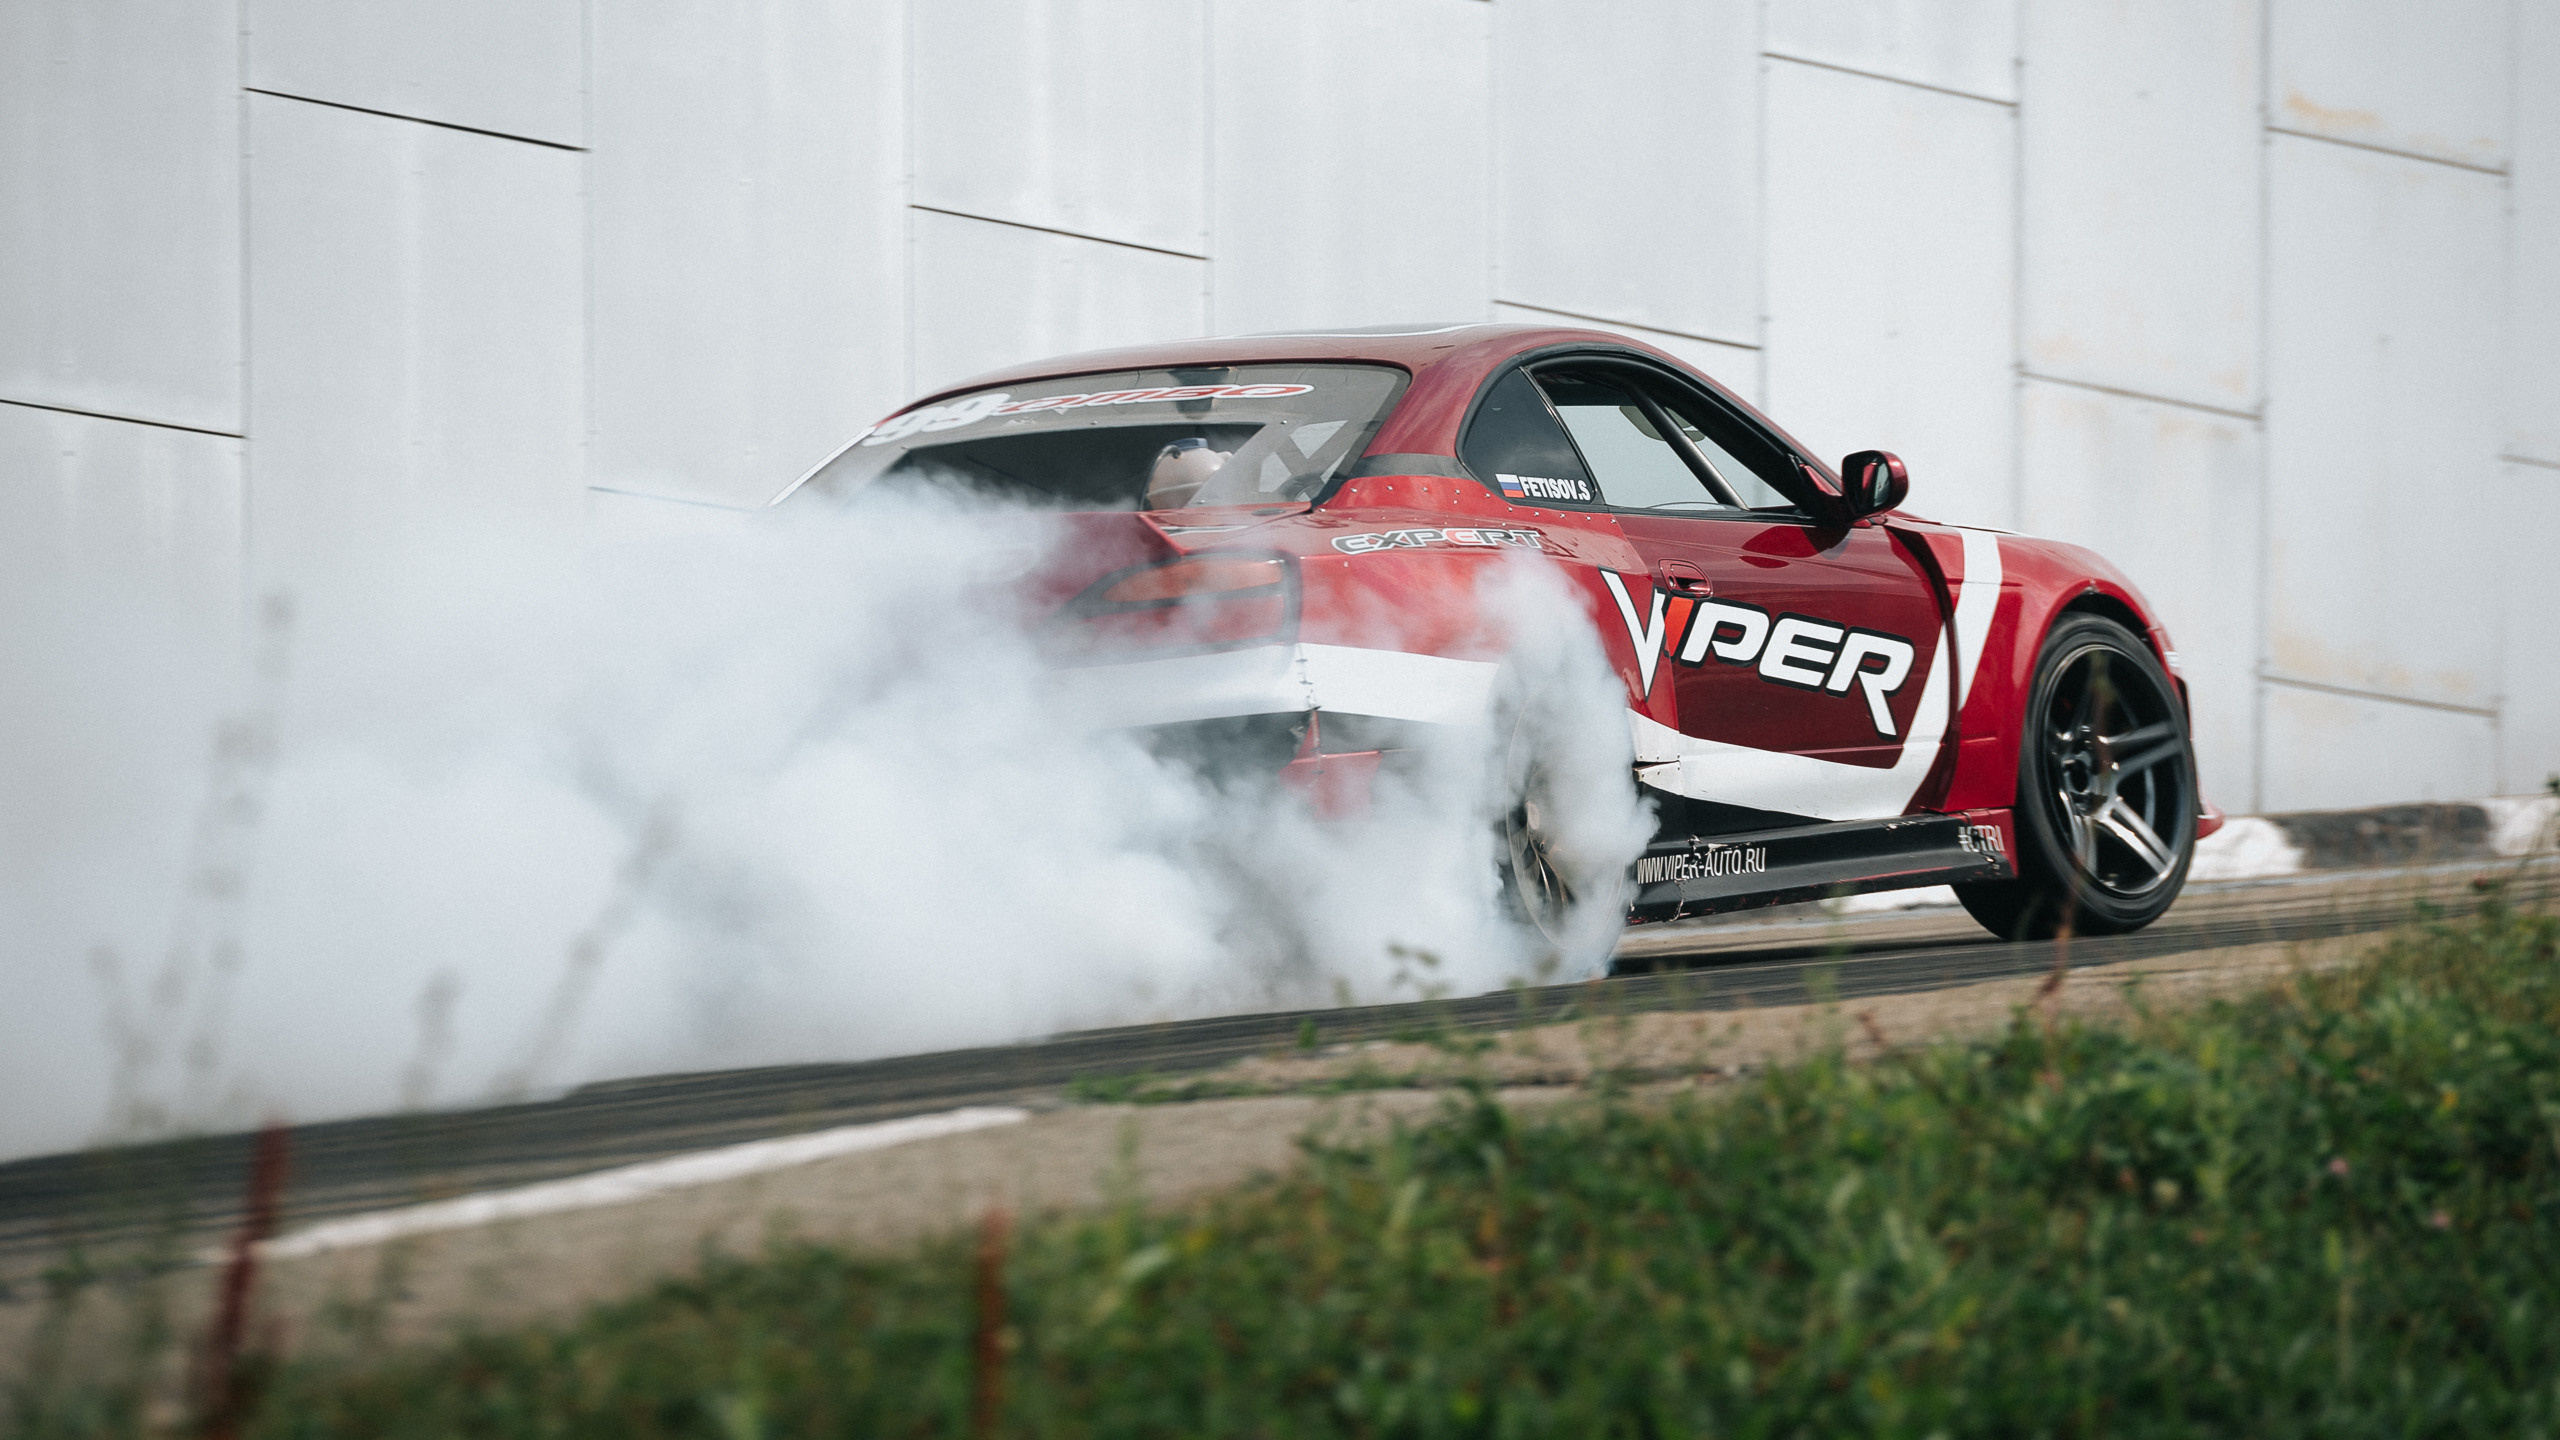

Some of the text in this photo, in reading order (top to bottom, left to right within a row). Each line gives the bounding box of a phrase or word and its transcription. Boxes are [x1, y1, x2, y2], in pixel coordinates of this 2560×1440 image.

[1518, 476, 1591, 501] FETISOV.S
[1331, 528, 1545, 555] EXPERT
[1598, 566, 1915, 740] VIPER
[1637, 847, 1767, 885] WWW.VIPER-AUTO.RU
